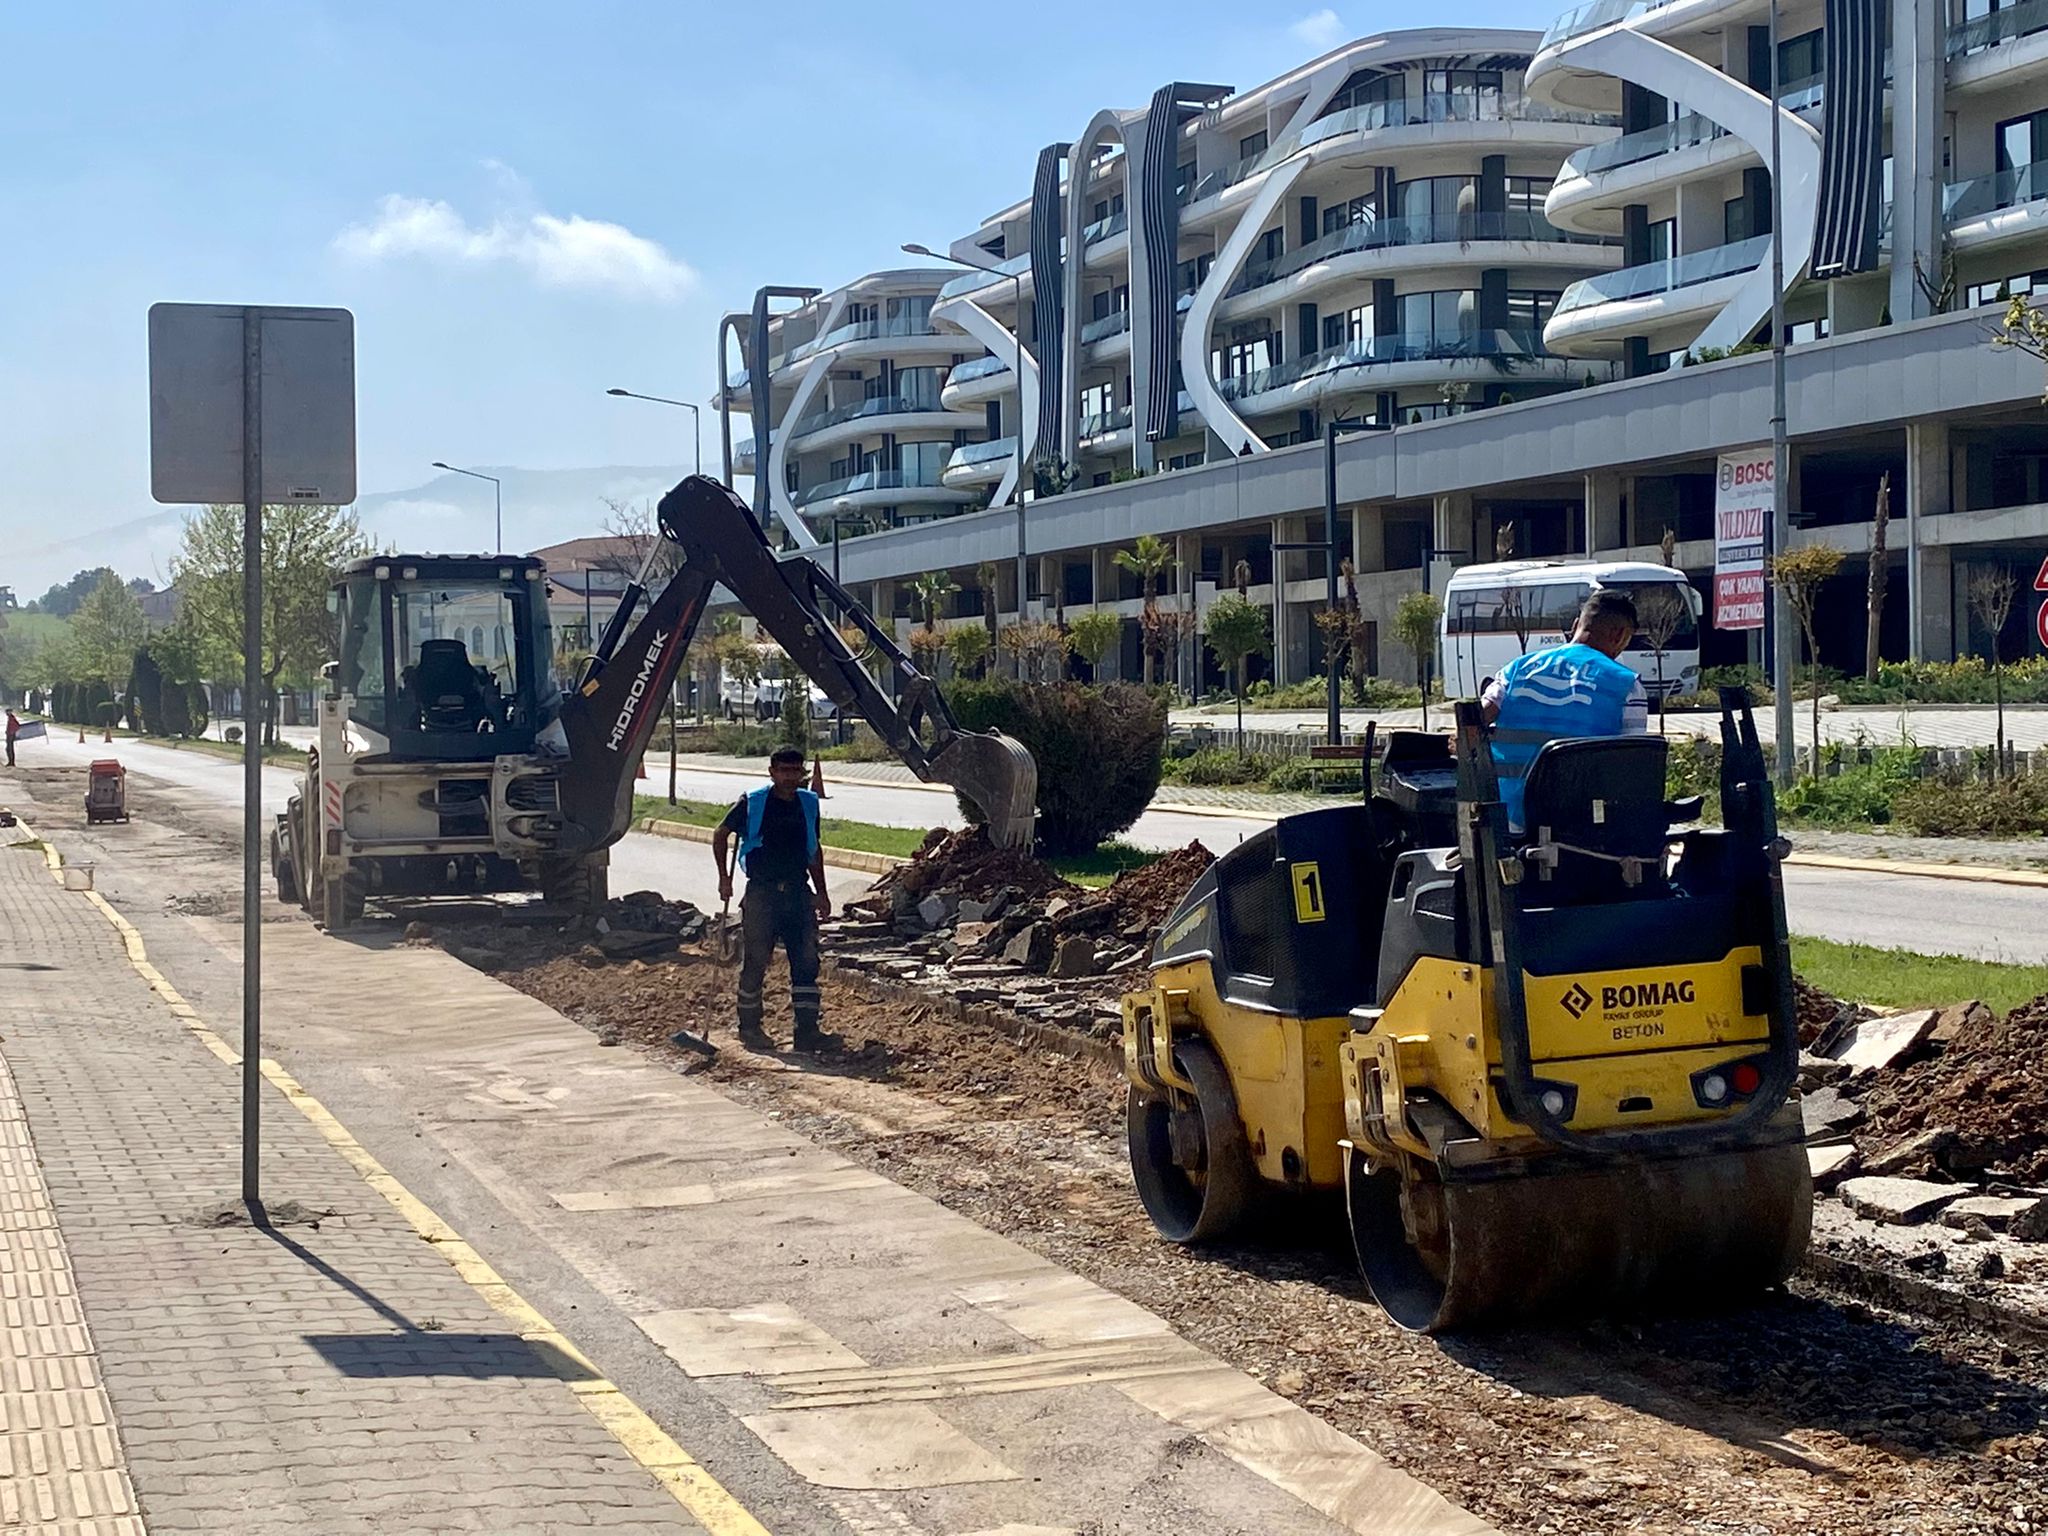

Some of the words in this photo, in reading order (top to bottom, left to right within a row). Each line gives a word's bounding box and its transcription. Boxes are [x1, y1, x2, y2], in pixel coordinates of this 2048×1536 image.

[1735, 460, 1774, 486] BOSC
[1718, 507, 1763, 541] YILDIZL
[1737, 575, 1764, 595] YAKIN
[1302, 871, 1320, 912] 1
[1602, 980, 1695, 1009] BOMAG
[1632, 1009, 1664, 1019] GROUP
[1612, 1023, 1665, 1040] BETON
